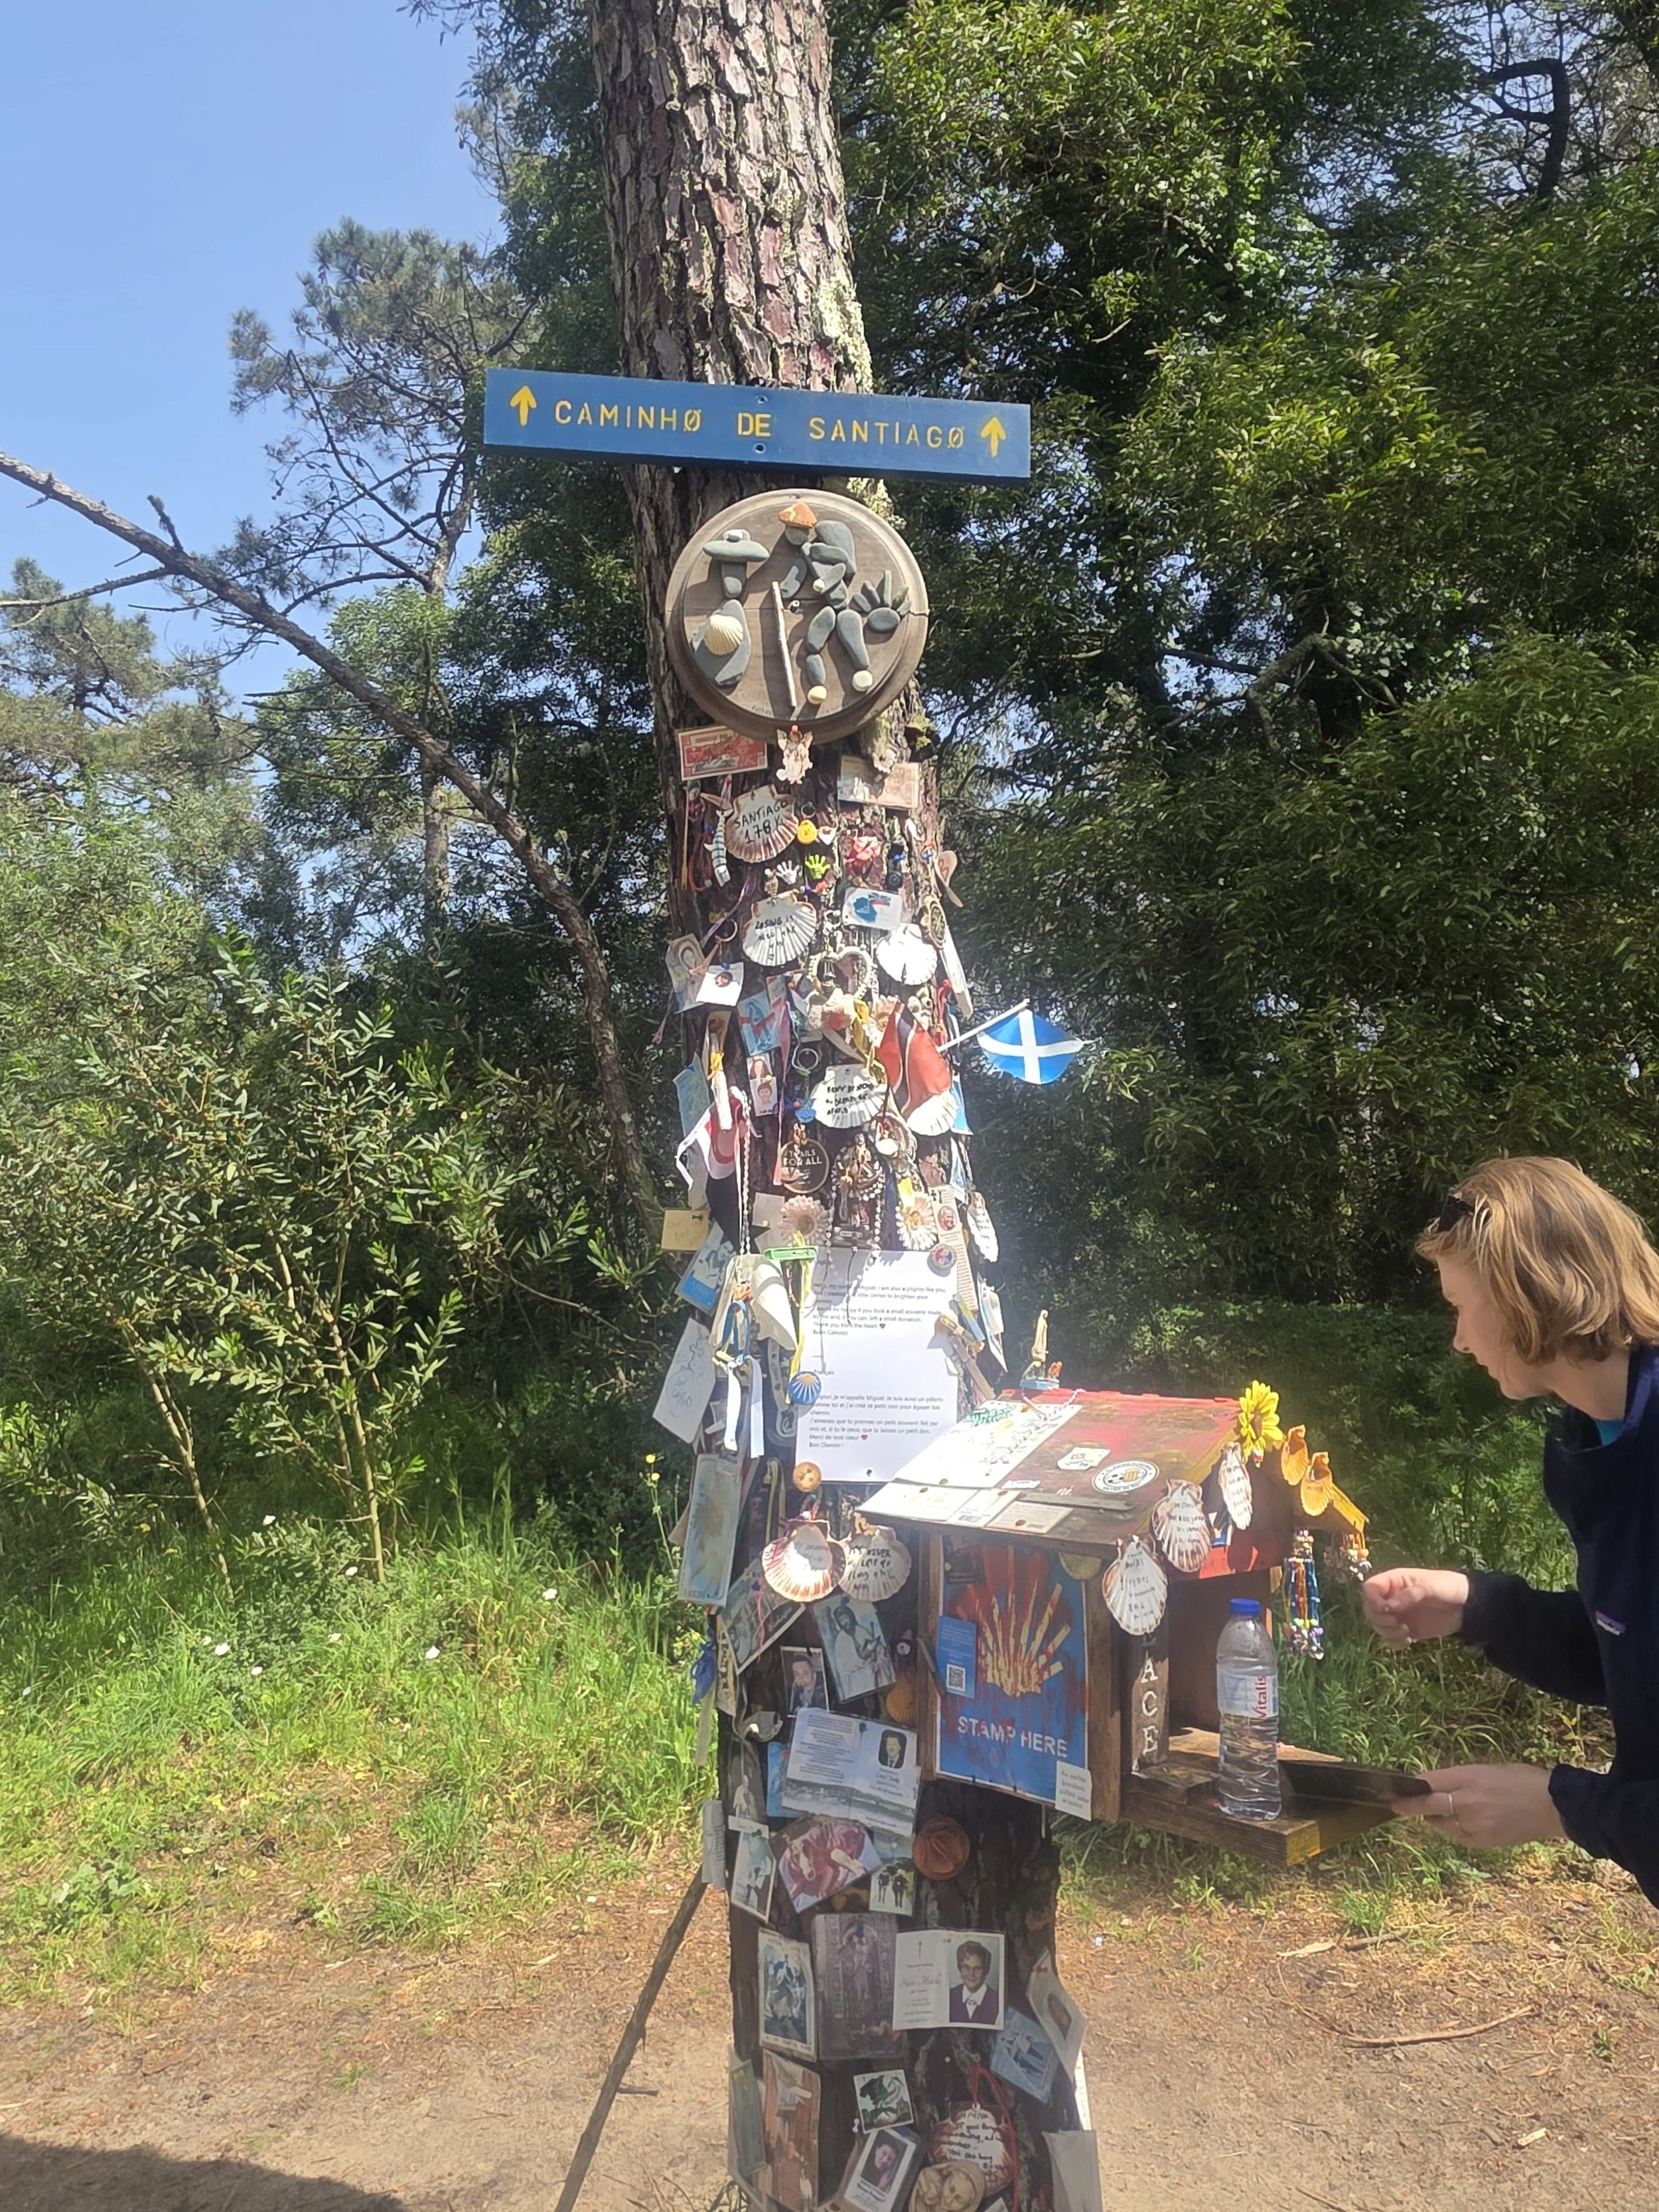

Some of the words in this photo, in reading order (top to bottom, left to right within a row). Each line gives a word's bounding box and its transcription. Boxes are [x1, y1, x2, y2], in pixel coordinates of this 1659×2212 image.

[737, 412, 772, 437] DE
[735, 799, 788, 830] SANTIAGO
[788, 1148, 816, 1157] TAILS
[805, 1155, 823, 1165] ALL
[1251, 1674, 1267, 1719] Vitalis
[957, 1716, 1017, 1744] STAMP
[1020, 1730, 1068, 1758] HERE
